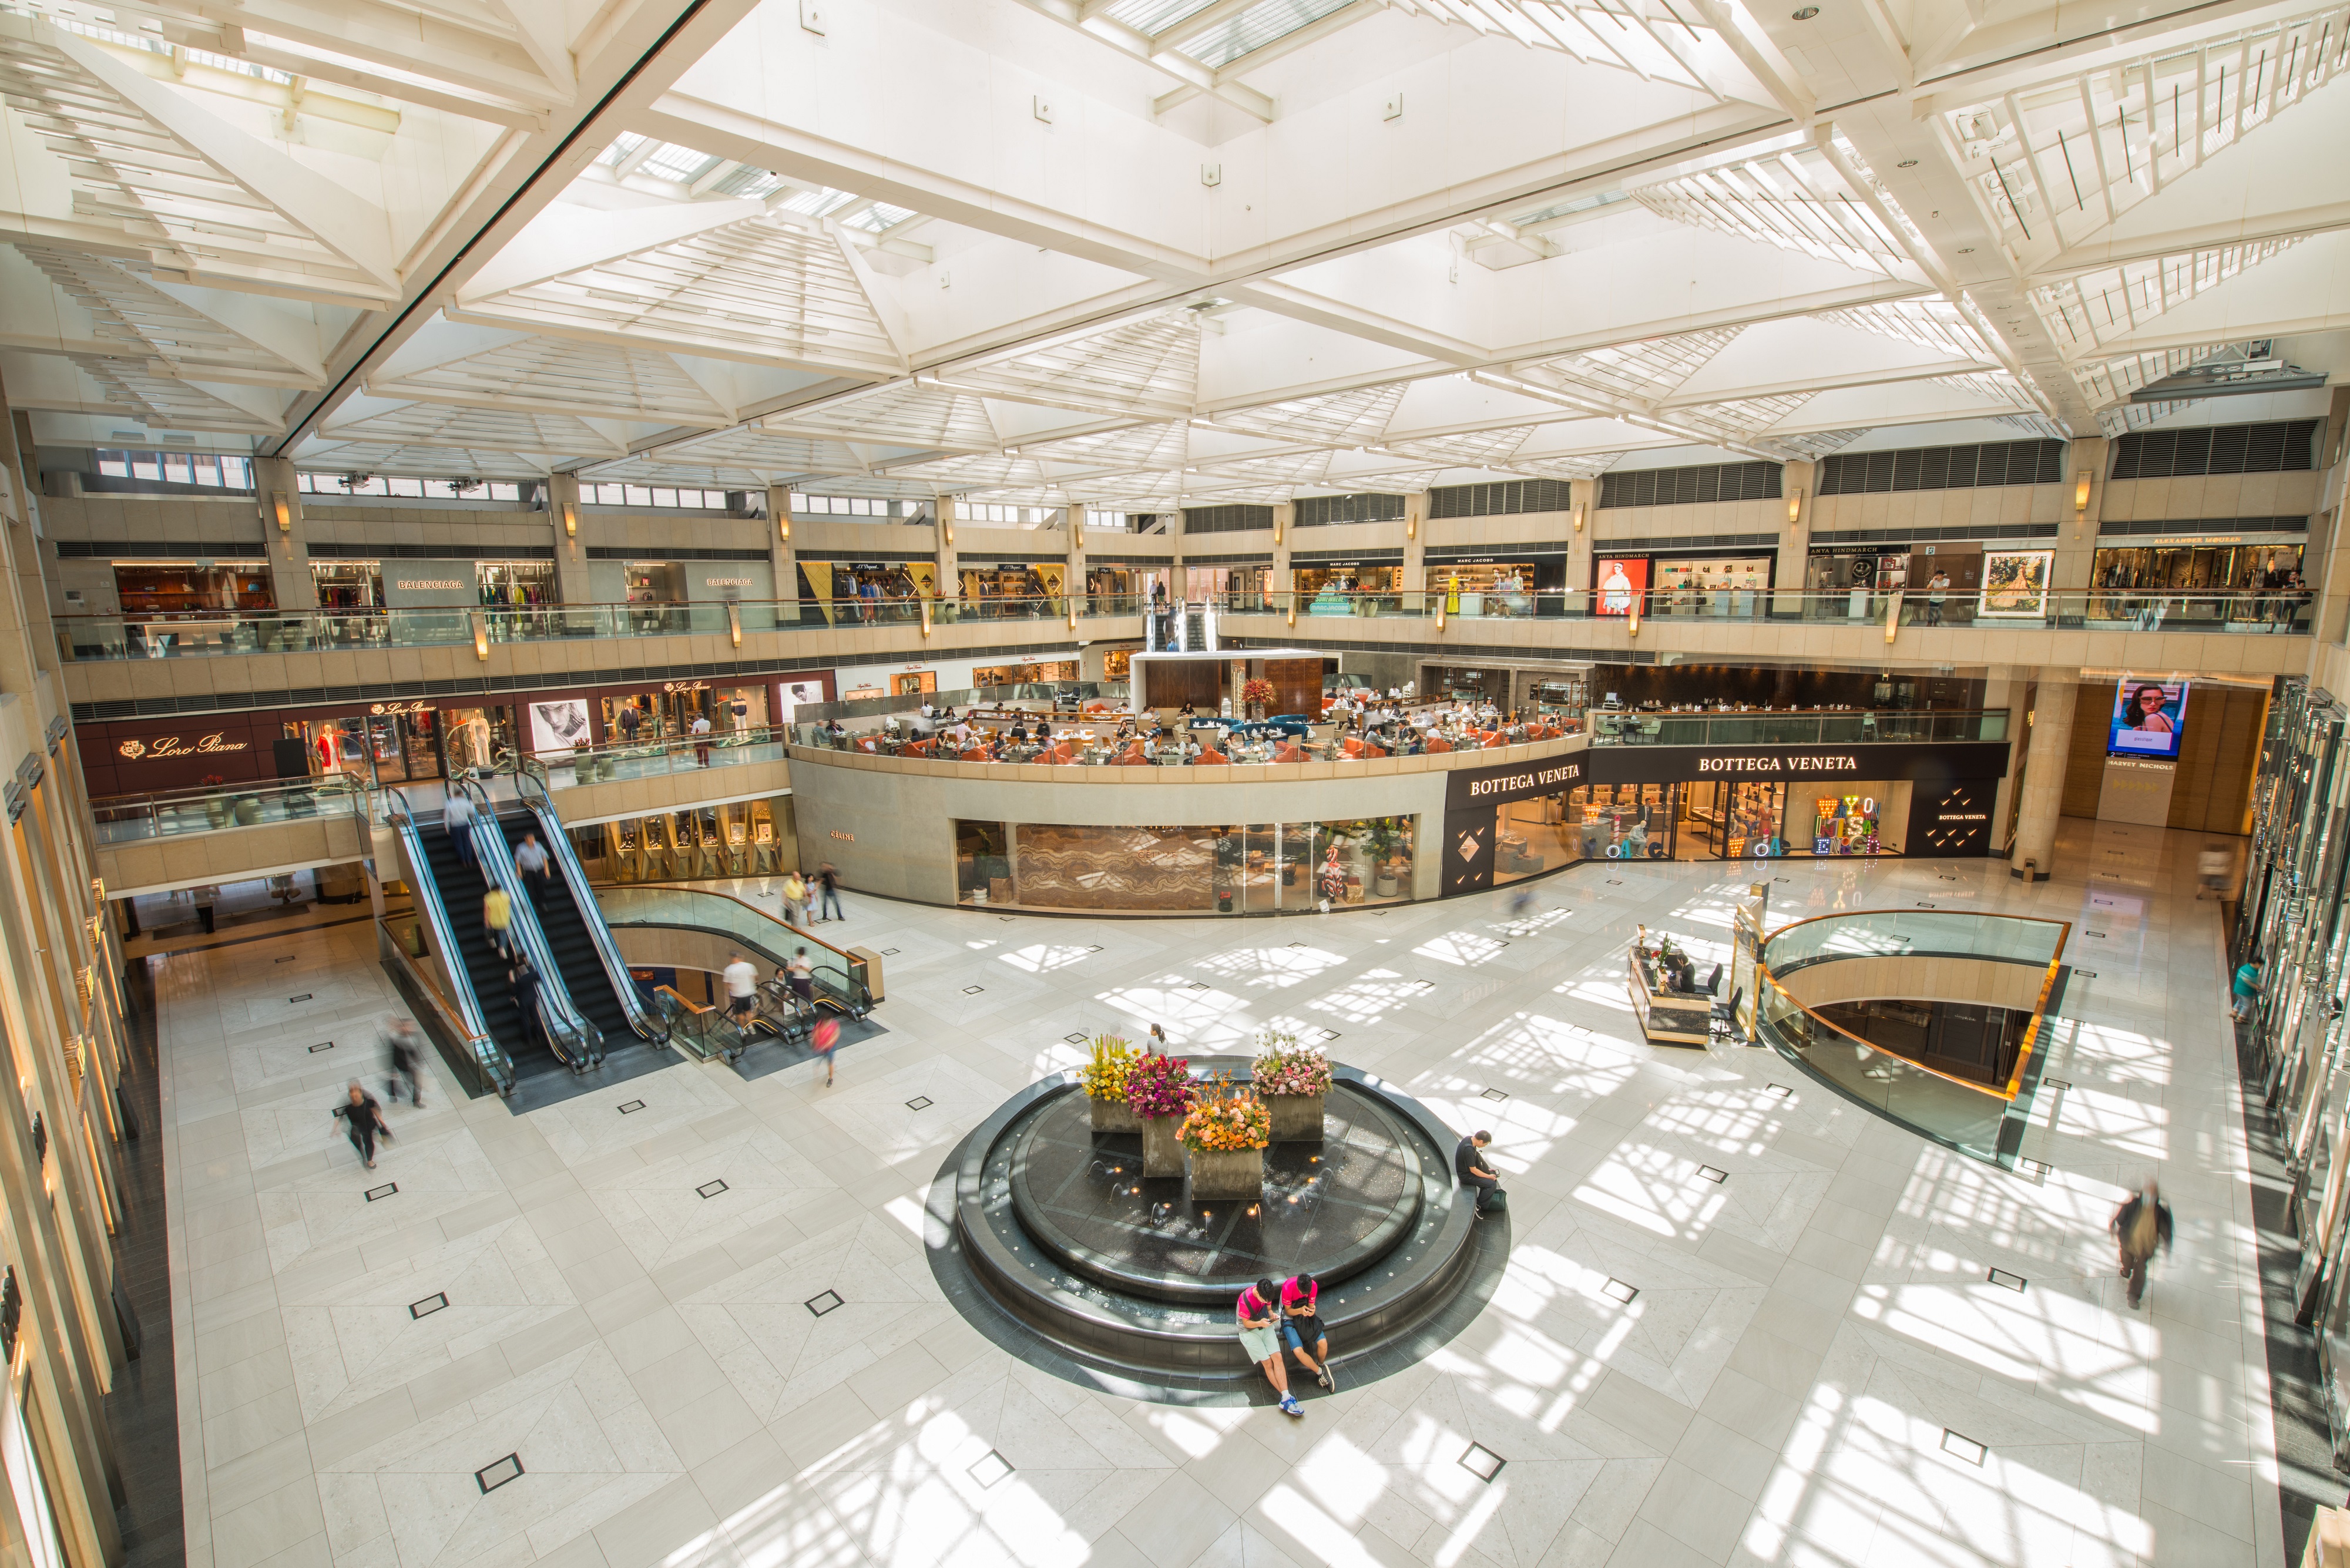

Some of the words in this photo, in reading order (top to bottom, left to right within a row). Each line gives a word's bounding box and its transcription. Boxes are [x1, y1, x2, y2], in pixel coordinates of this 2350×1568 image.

[398, 580, 464, 589] BALENCIAGA
[674, 681, 692, 691] Loro
[691, 680, 711, 690] Piana
[385, 703, 409, 714] Loro
[409, 700, 437, 712] Piana
[147, 737, 195, 758] Loro
[197, 732, 248, 753] Piana
[1698, 758, 1781, 771] BOTTEGA
[1787, 757, 1856, 770] VENETA
[1471, 774, 1535, 796] BOTTEGA
[1538, 764, 1579, 784] VENETA
[830, 830, 854, 842] CÉLINE
[1138, 850, 1176, 858] CÉLINE
